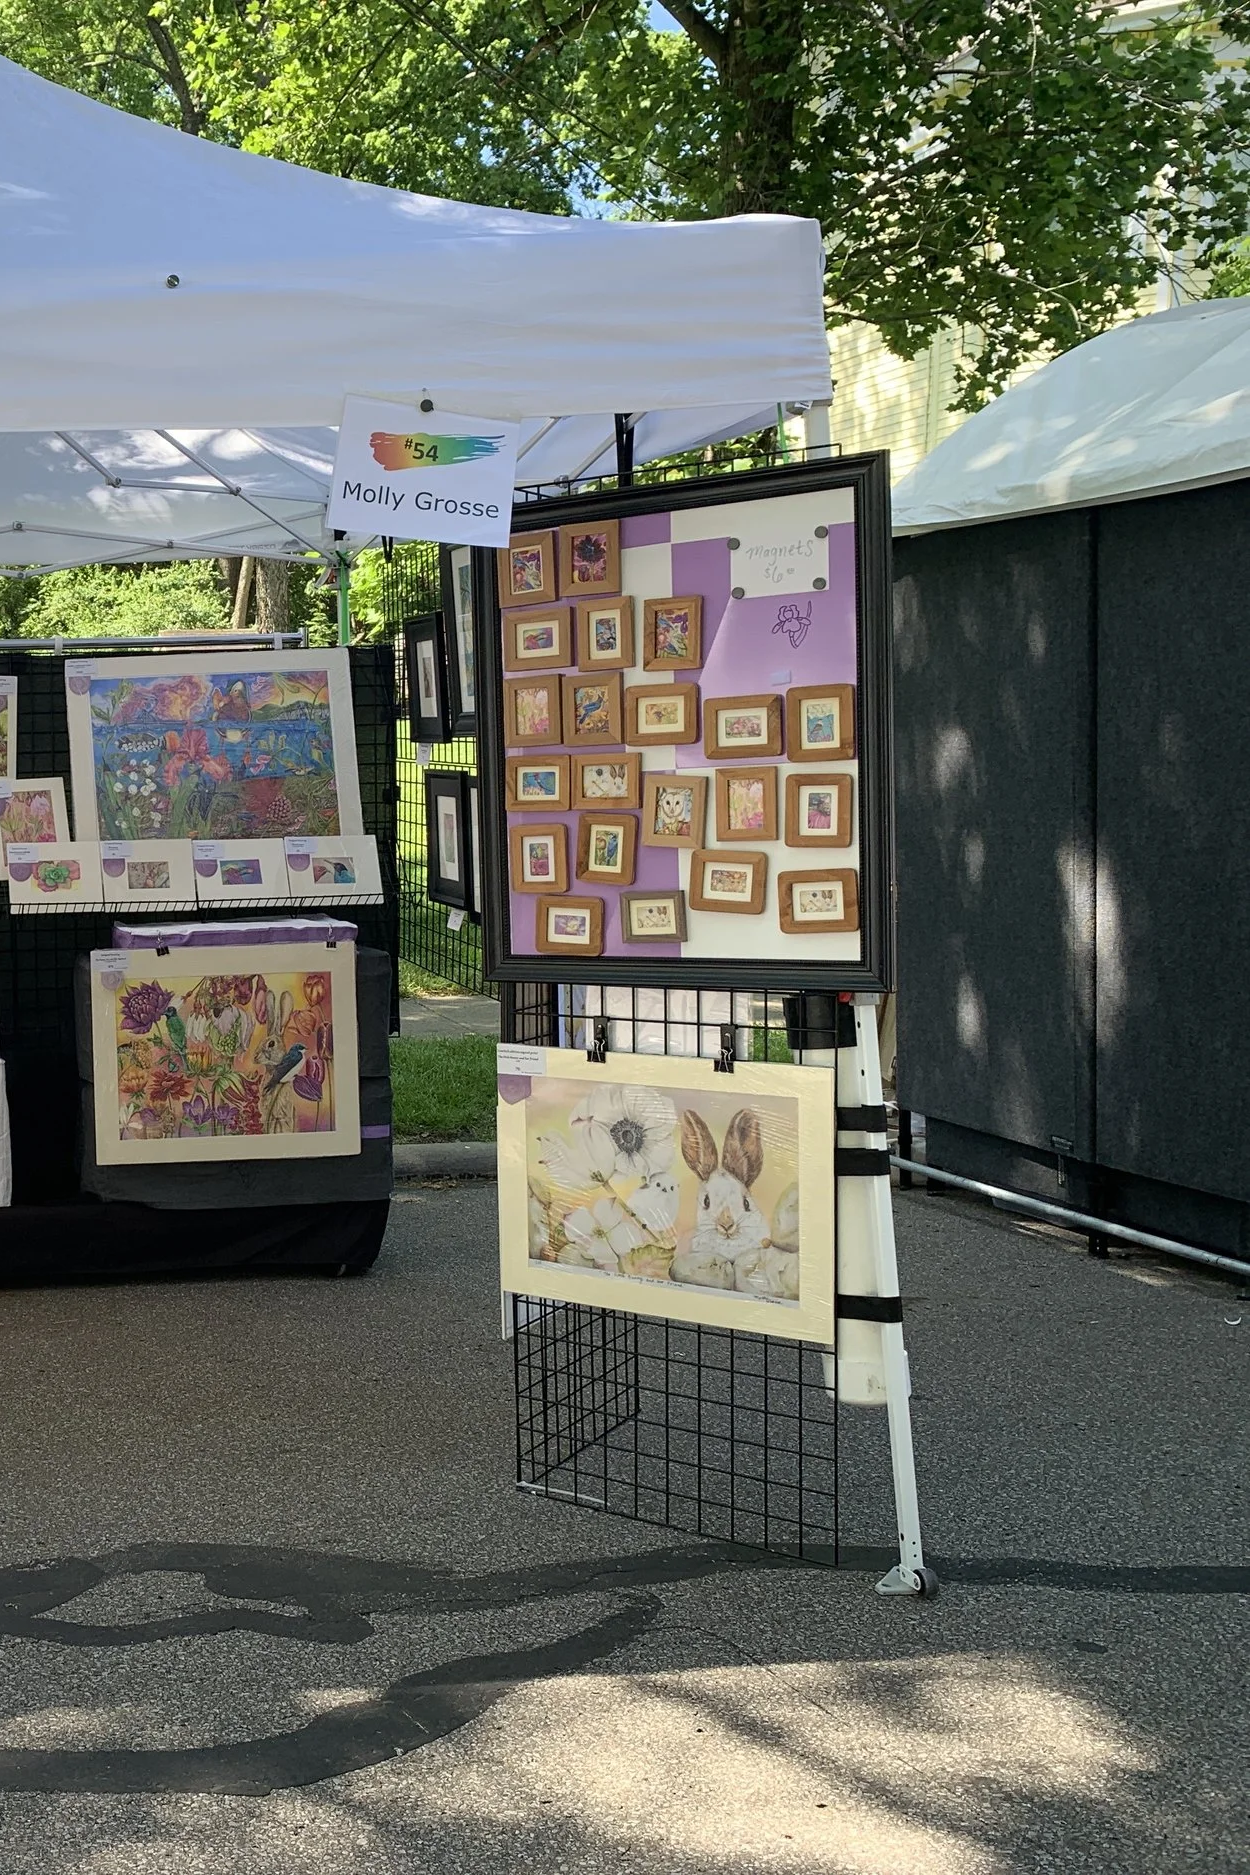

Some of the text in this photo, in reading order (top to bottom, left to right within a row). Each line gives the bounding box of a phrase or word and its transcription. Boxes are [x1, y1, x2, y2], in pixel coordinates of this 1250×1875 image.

[403, 437, 439, 462] #54
[342, 480, 500, 519] Molly Grosse
